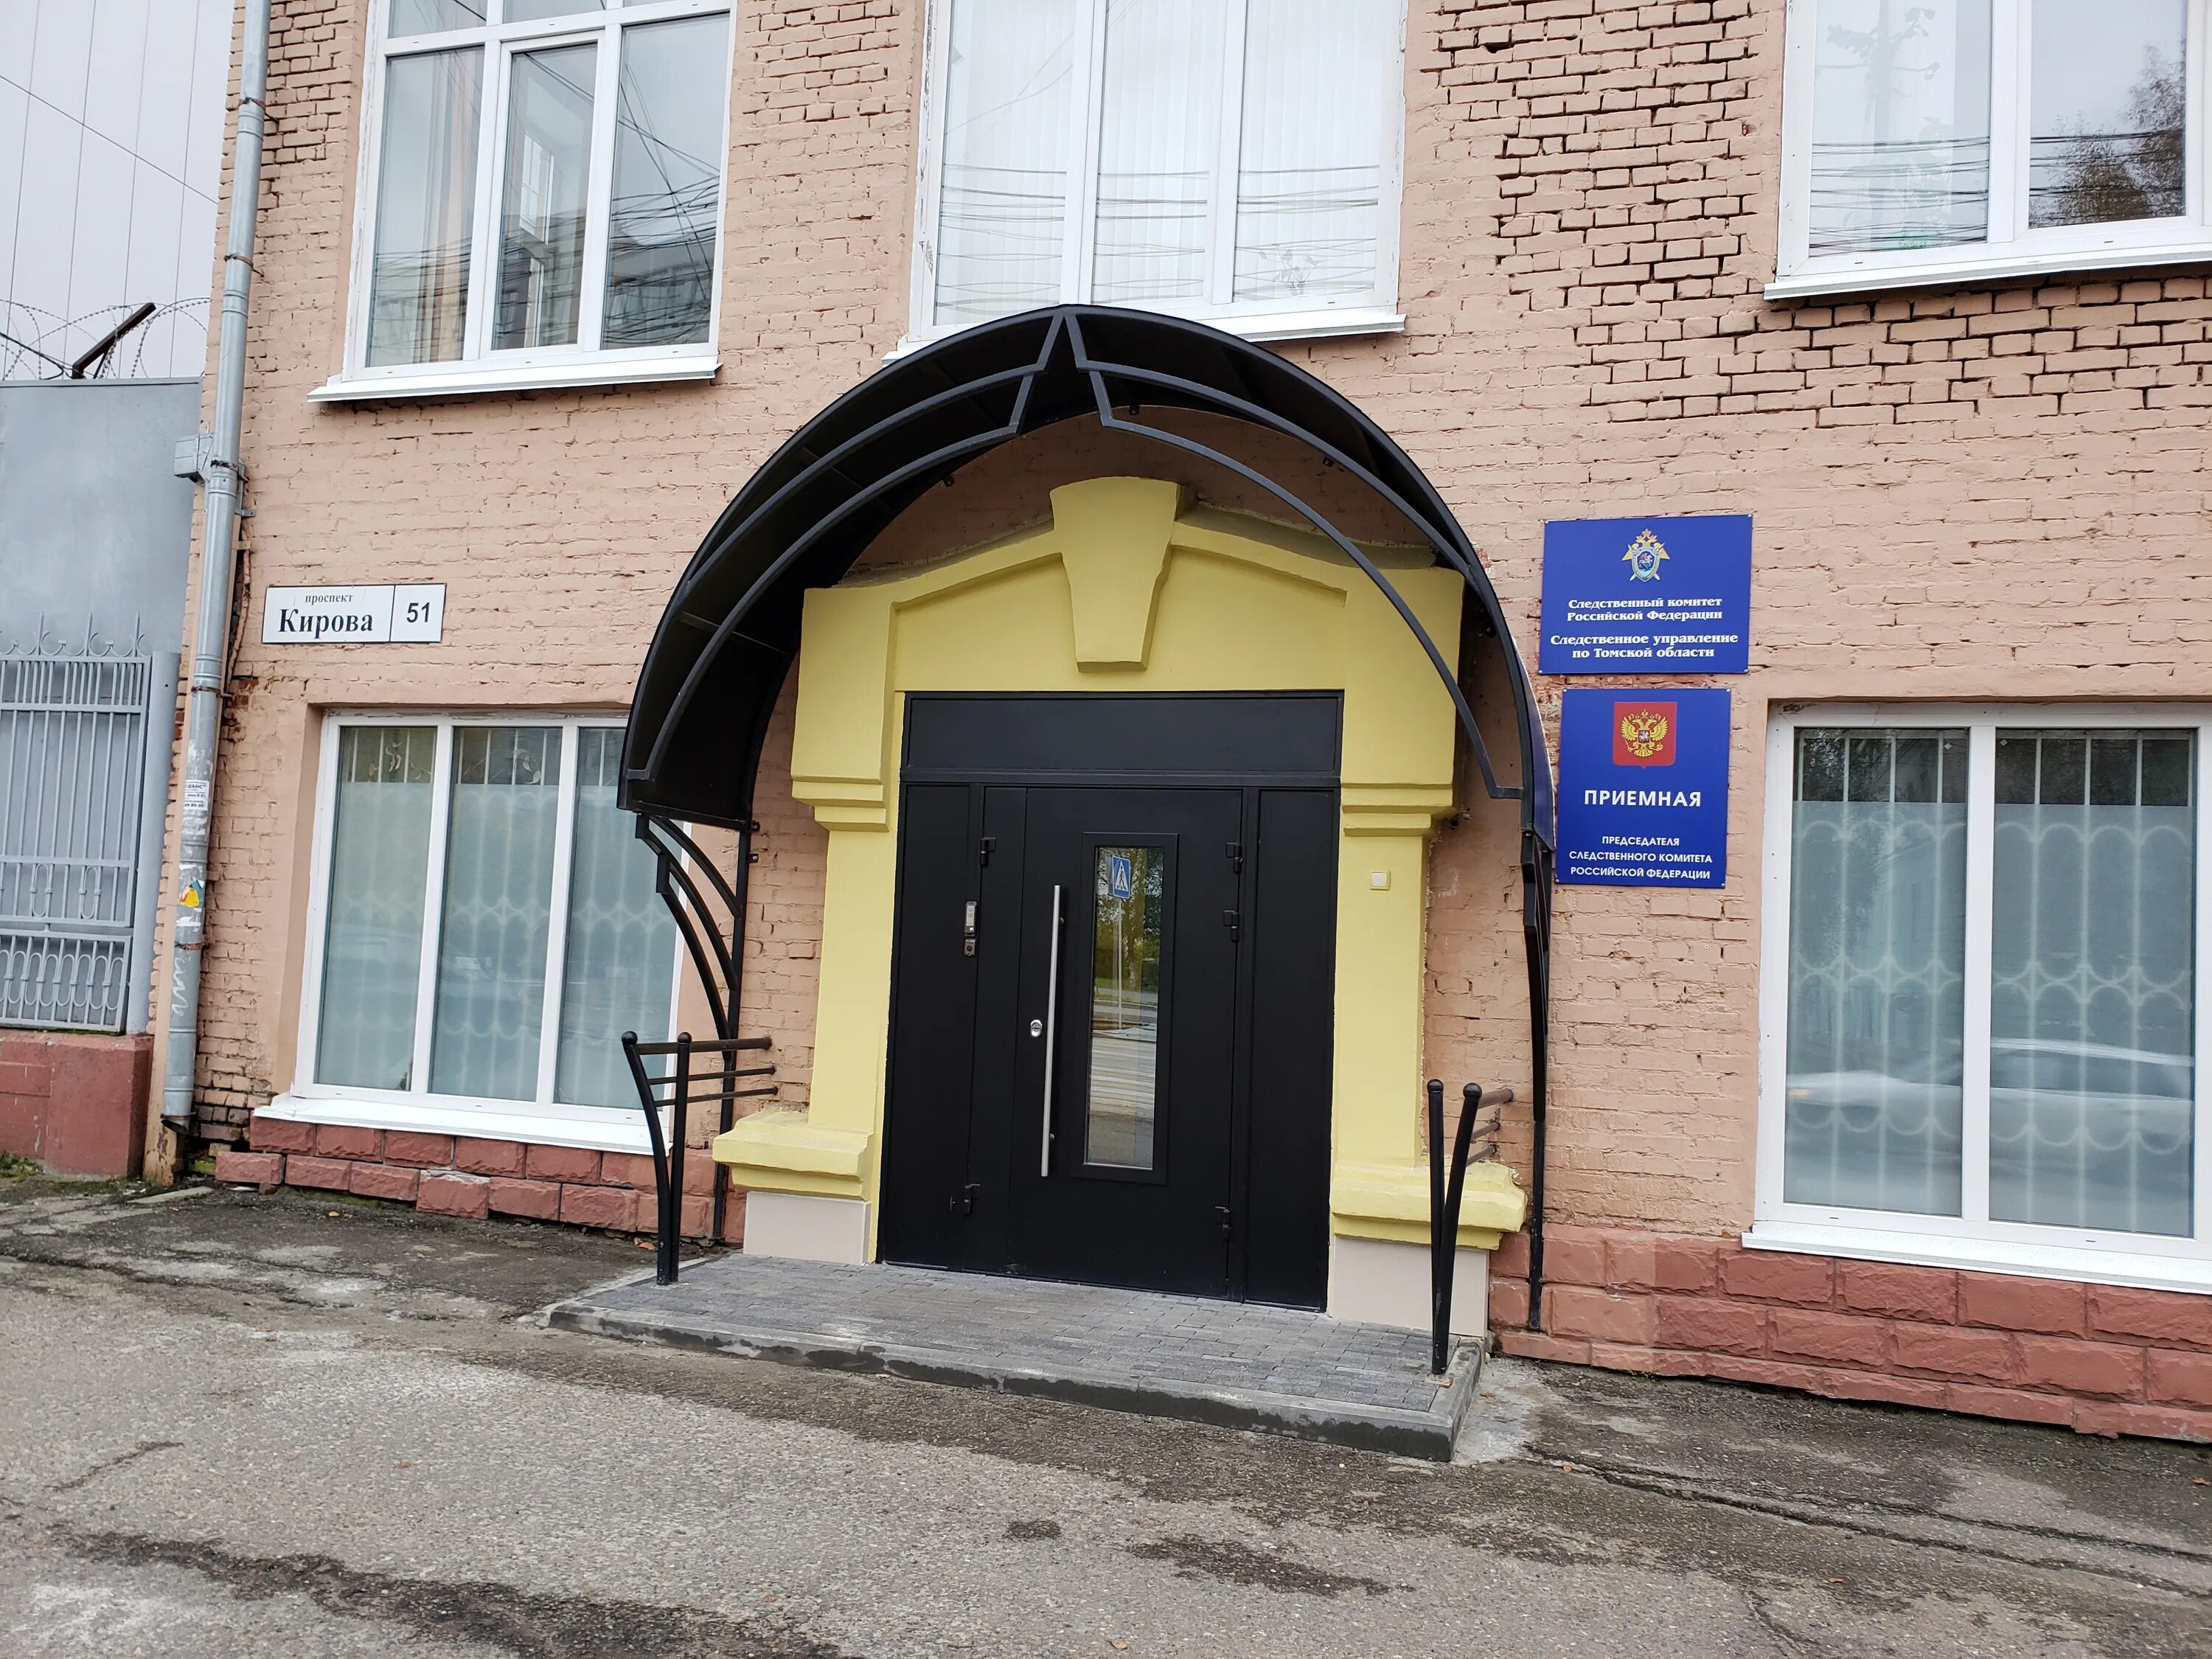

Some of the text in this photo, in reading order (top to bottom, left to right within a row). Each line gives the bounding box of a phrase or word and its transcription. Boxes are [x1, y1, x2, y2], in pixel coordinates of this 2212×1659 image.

[305, 594, 354, 605] проспект
[1568, 598, 1722, 610] Следственный комитет
[406, 602, 430, 623] 51
[1567, 611, 1722, 622] Российской Федерации
[277, 608, 373, 639] Кирова
[1550, 634, 1739, 647] Следственное управление
[1572, 647, 1714, 658] по Томской области
[1584, 790, 1701, 807] ПРИЕМНАЯ
[1601, 835, 1680, 846] ПРЕДСЕДАТЕЛЯ
[1568, 851, 1713, 863] СЛЕДСТВЕННОГО КОМИТЕТА
[1570, 866, 1711, 880] РОССИЙСКОЙ ФЕДЕРАЦИИ
